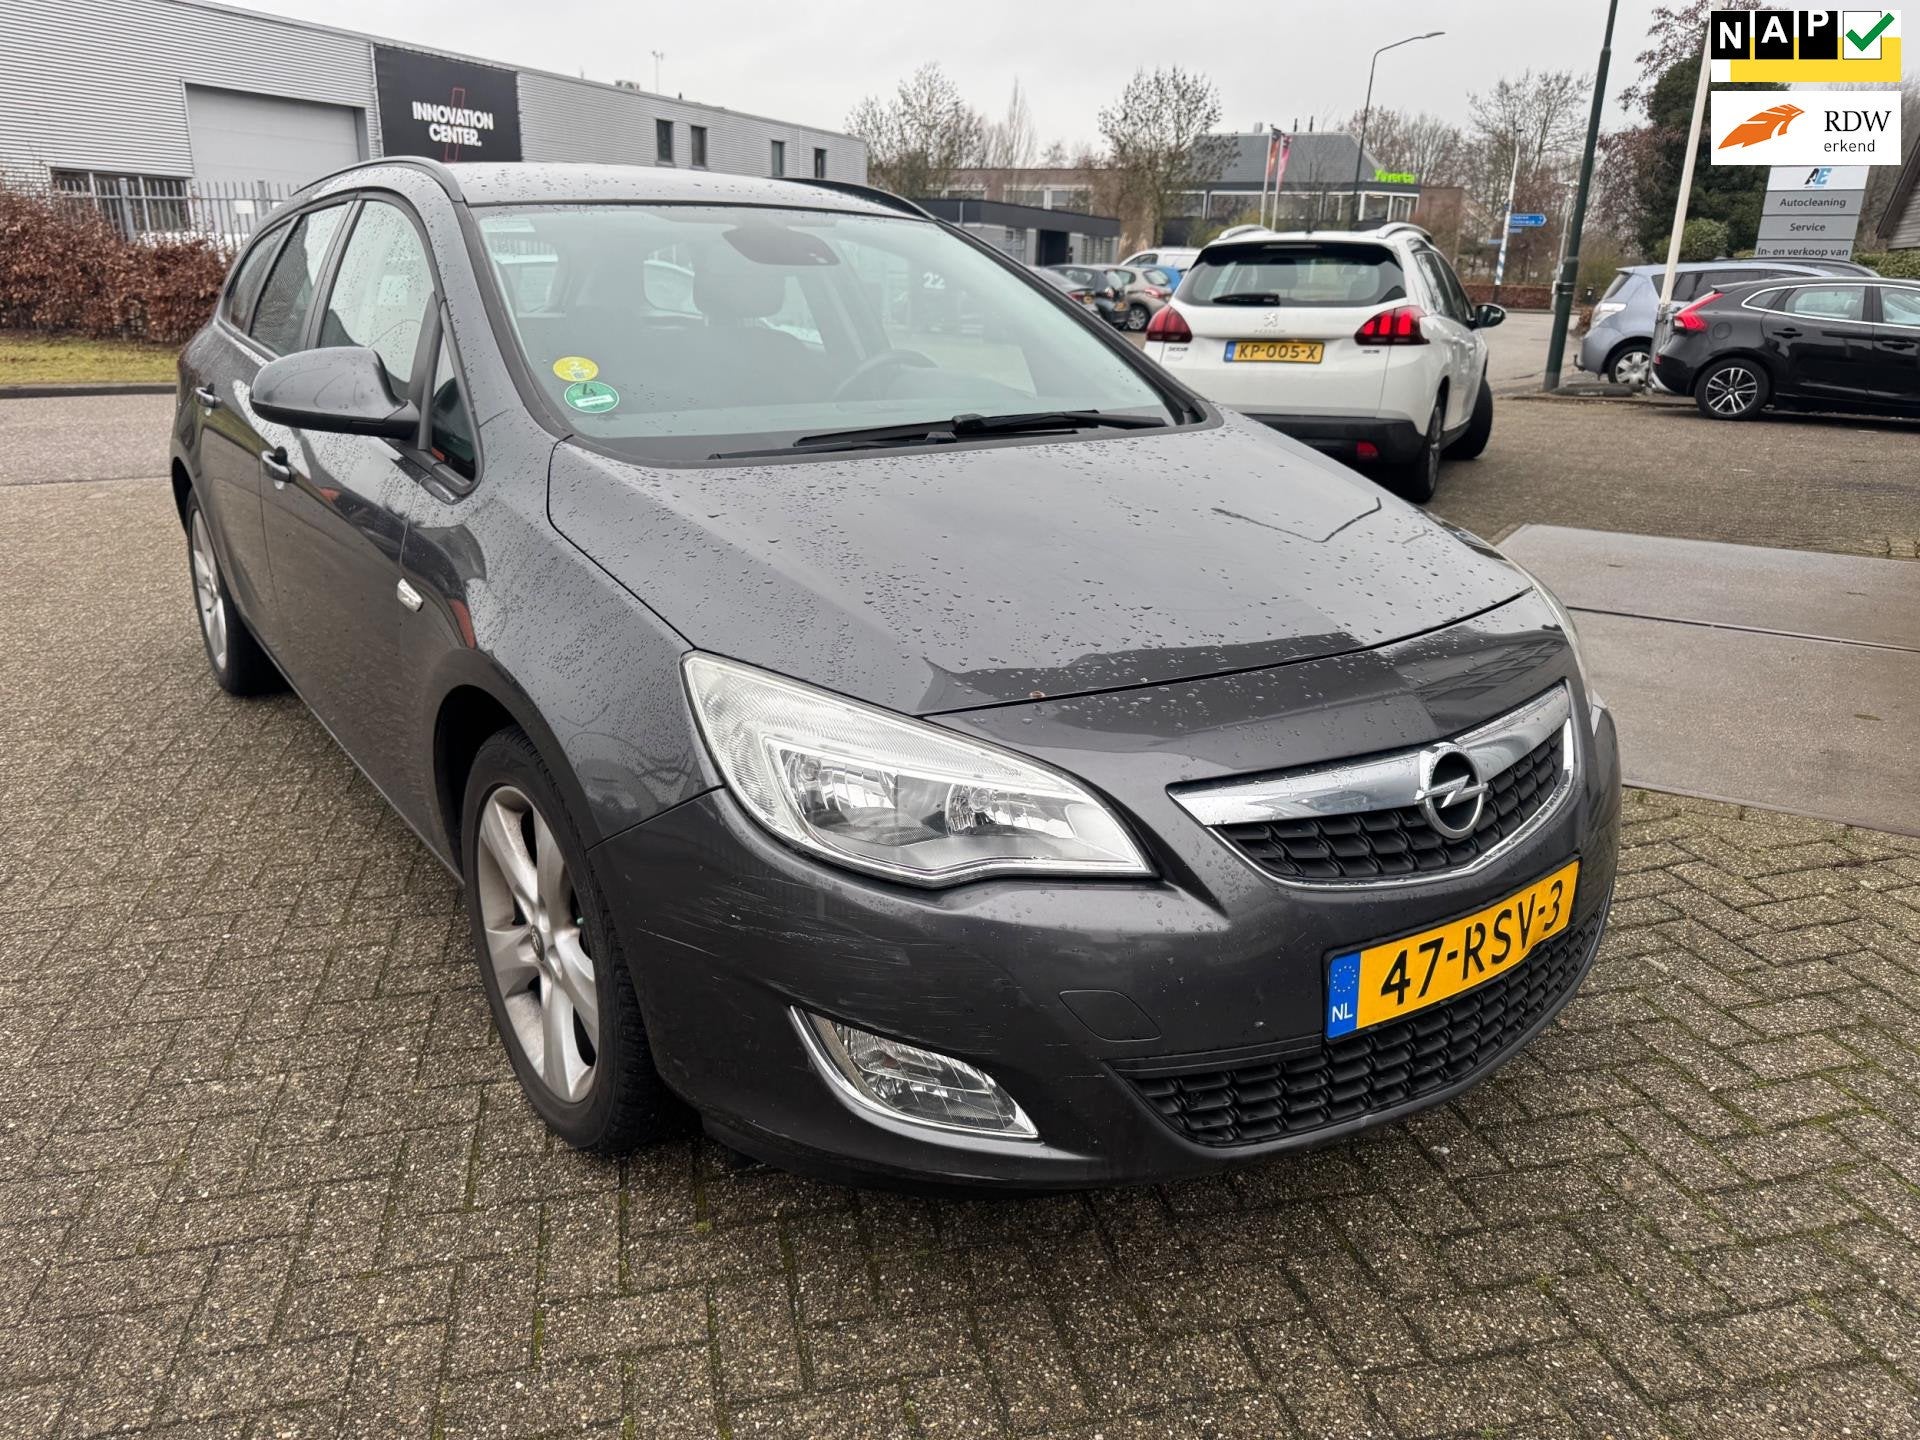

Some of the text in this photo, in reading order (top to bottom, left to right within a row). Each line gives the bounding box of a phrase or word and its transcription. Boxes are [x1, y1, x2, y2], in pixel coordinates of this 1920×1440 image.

[412, 101, 494, 130] INNOVATION
[429, 123, 482, 147] CENTER.
[1780, 198, 1847, 208] Autocleaning
[1790, 222, 1826, 232] Service
[1758, 247, 1771, 255] In-
[1787, 247, 1828, 257] verkoop
[1238, 344, 1318, 360] KP-005-X
[1380, 879, 1563, 1005] 47-RSV-3
[1332, 1003, 1353, 1023] NL
